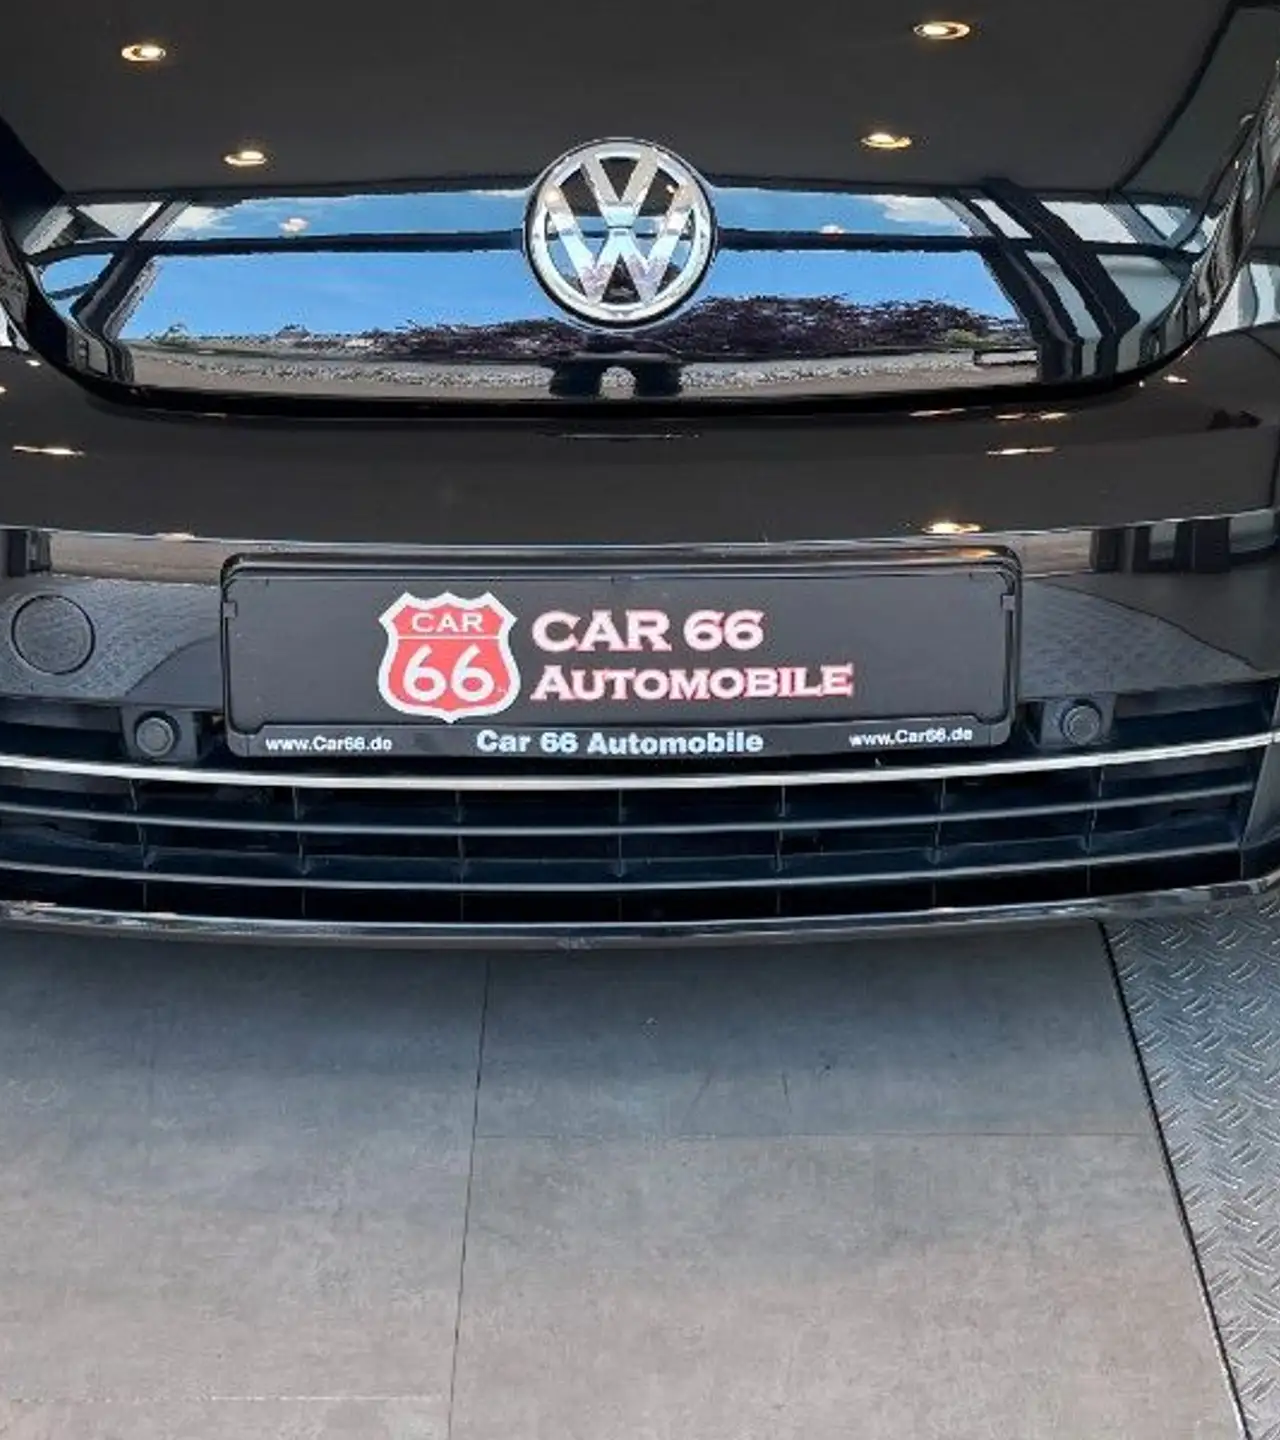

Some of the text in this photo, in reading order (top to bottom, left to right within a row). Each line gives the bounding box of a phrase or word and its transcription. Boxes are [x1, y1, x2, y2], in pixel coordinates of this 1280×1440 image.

[411, 612, 484, 633] CAR
[531, 609, 765, 653] CAR 66
[402, 643, 495, 703] 66
[530, 662, 855, 702] AUTOMOBILE
[265, 735, 393, 752] www.Car66.de
[476, 729, 765, 756] Car 66 Automobile
[848, 726, 973, 748] www.Car66.de
